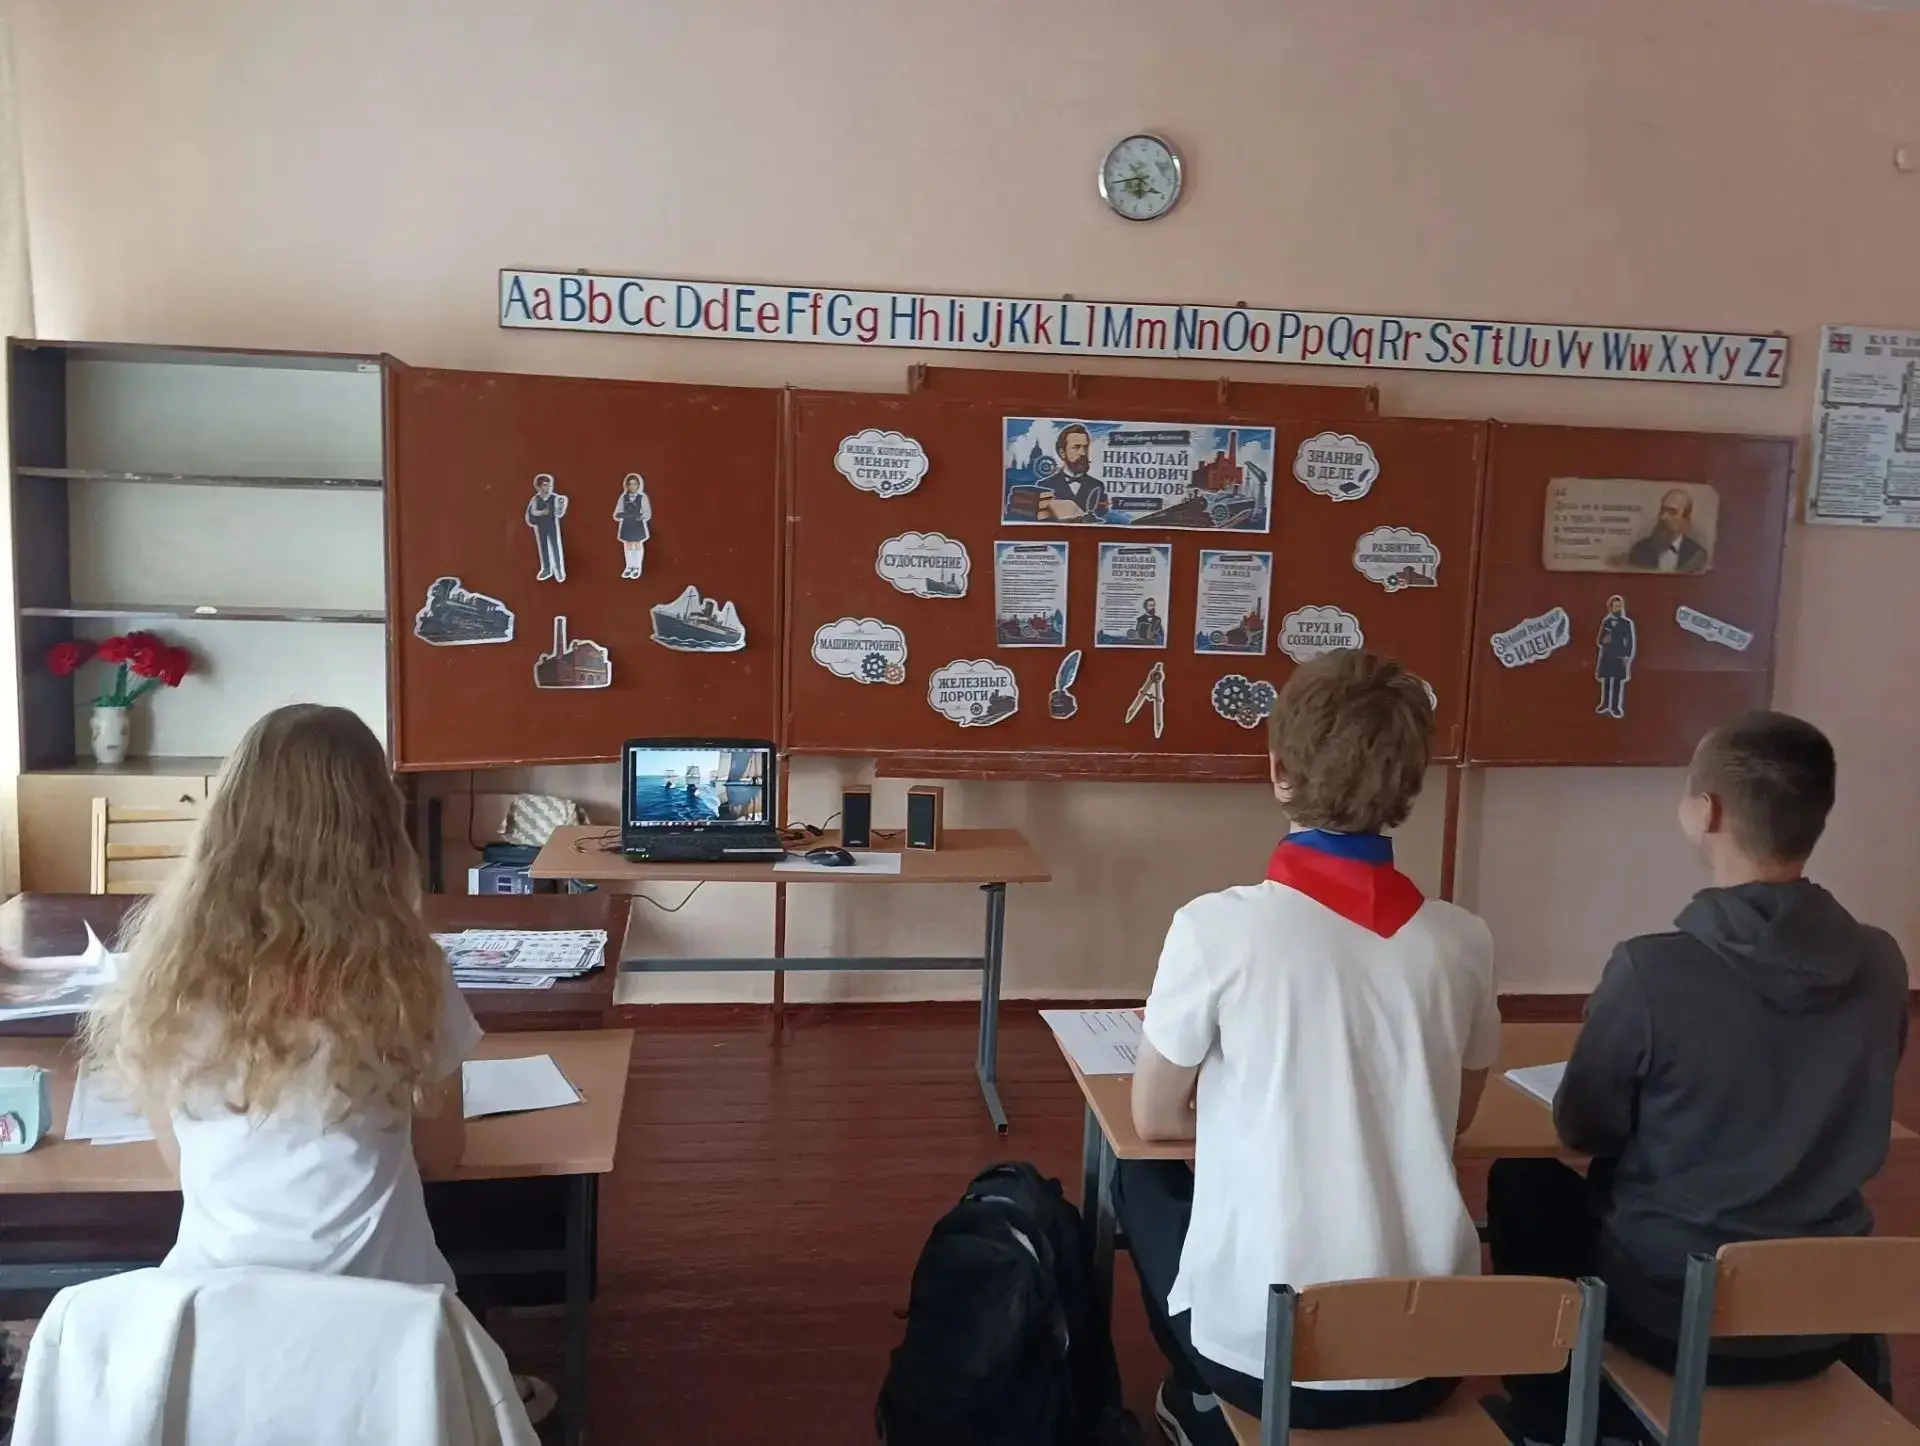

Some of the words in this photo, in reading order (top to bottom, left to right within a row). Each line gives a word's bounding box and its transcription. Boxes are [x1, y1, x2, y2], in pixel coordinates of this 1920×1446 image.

[853, 456, 910, 468] МЕНЯЮТ
[1103, 450, 1189, 466] НИКОЛАЙ
[1307, 449, 1363, 465] ЗНАНИЯ
[856, 468, 907, 480] СТРАНУ
[1102, 466, 1188, 480] ИВАНОВИЧ
[1307, 465, 1316, 478] В
[1318, 466, 1355, 480] ДЕЛЕ
[1106, 481, 1184, 495] ПУТИЛОВ
[884, 554, 962, 569] СУДОСТРОЕНИЕ
[1297, 622, 1330, 634] ТРУД
[1334, 622, 1343, 633] И
[820, 638, 900, 651] МАШИНОСТРОЕНИЕ
[1287, 634, 1352, 647] СОЗИДАНИЕ
[938, 676, 1008, 689] ЖЕЛЕЗНЫЕ
[939, 690, 989, 703] ДОРОГИ
